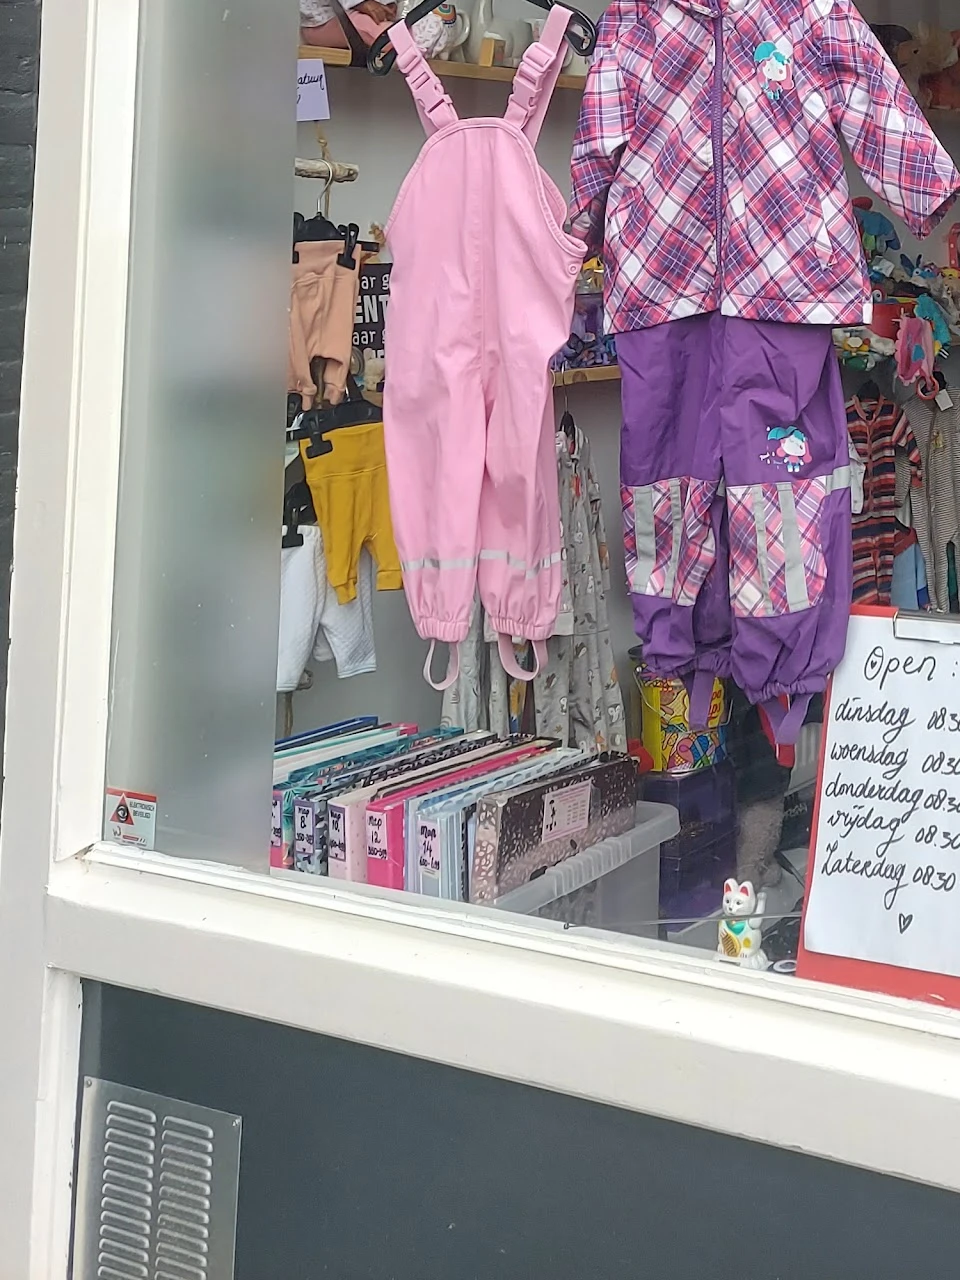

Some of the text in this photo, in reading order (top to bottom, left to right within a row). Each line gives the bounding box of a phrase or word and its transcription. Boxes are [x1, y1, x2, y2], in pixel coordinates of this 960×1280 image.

[835, 698, 916, 744] dinsdag
[830, 742, 909, 780] woensdag
[825, 772, 924, 824] donderdag
[371, 831, 382, 843] 12
[422, 840, 433, 857] 14
[827, 805, 905, 858] vrijdag
